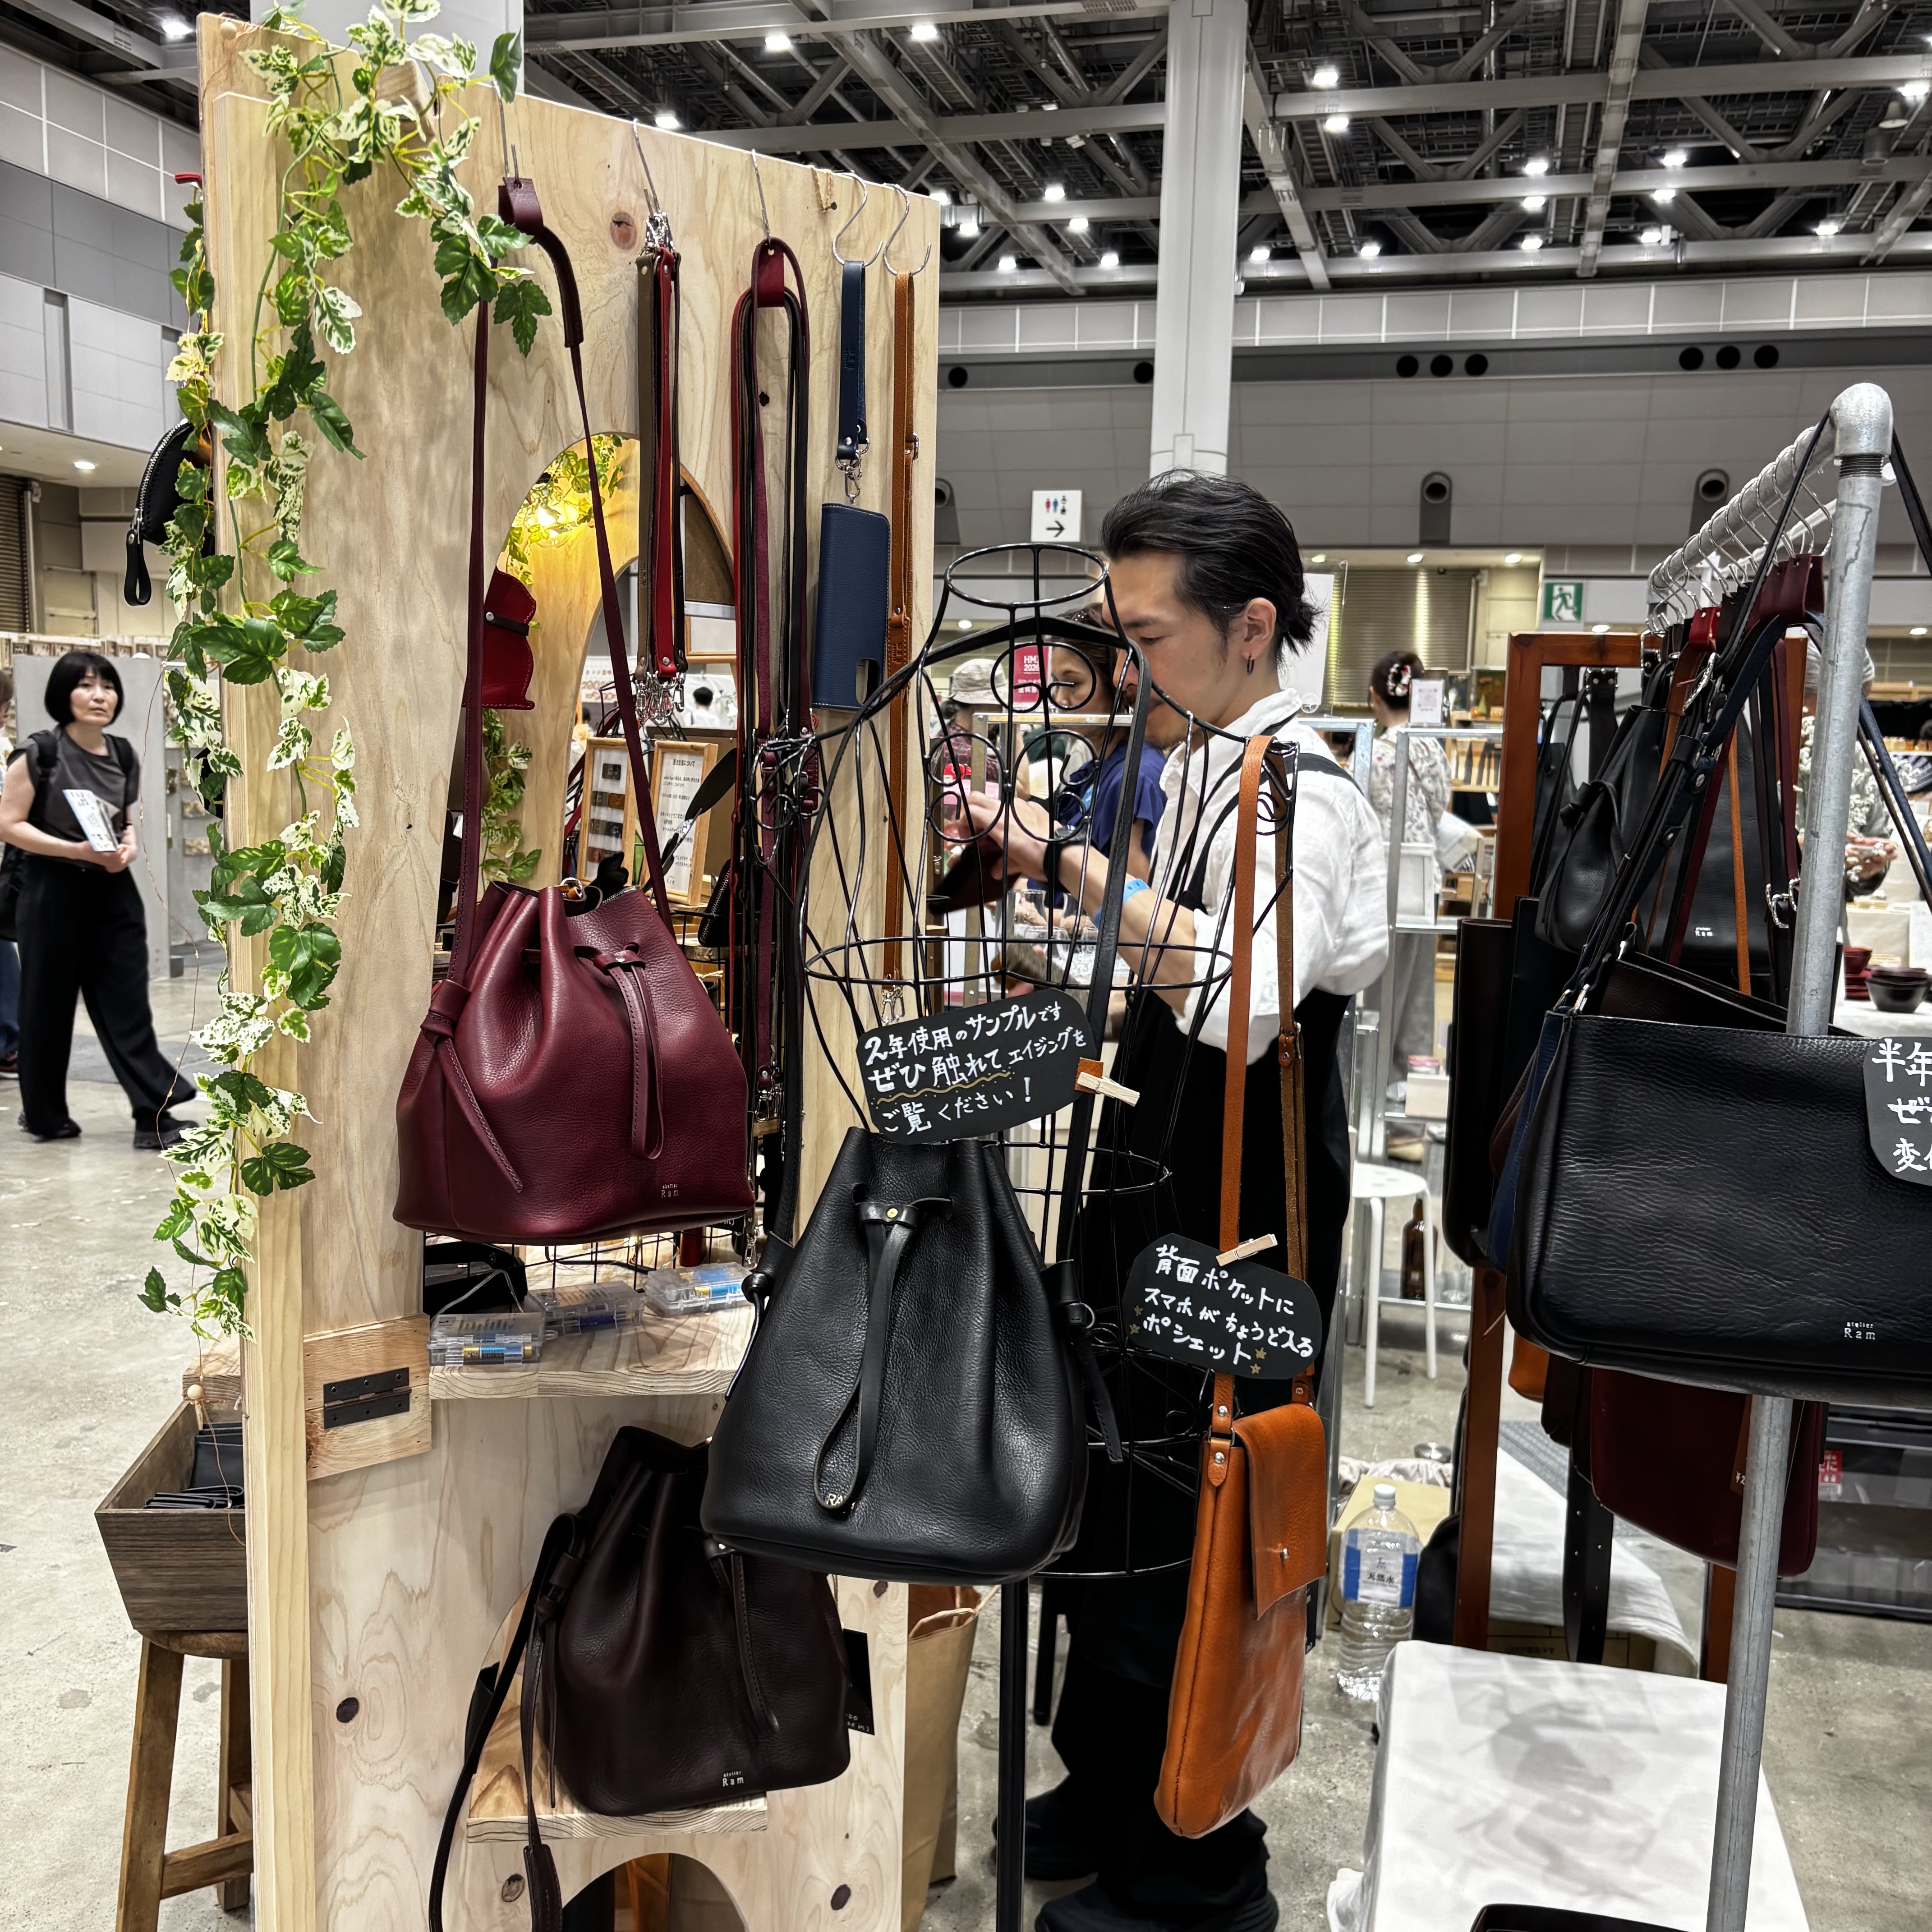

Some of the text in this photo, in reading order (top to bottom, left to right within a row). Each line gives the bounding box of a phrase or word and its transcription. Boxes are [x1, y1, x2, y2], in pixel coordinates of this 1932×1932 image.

[864, 1001, 1062, 1066] 2年使用のサンプルです
[1887, 1096, 1932, 1124] ぜ
[1155, 1244, 1294, 1315] 背面ポケットに
[1143, 1313, 1251, 1365] ポシェット
[1144, 1288, 1313, 1357] スマホがちょうど入る
[1844, 1327, 1876, 1340] Ram
[1736, 1471, 1745, 1485] ¥2
[722, 1777, 744, 1787] Ram
